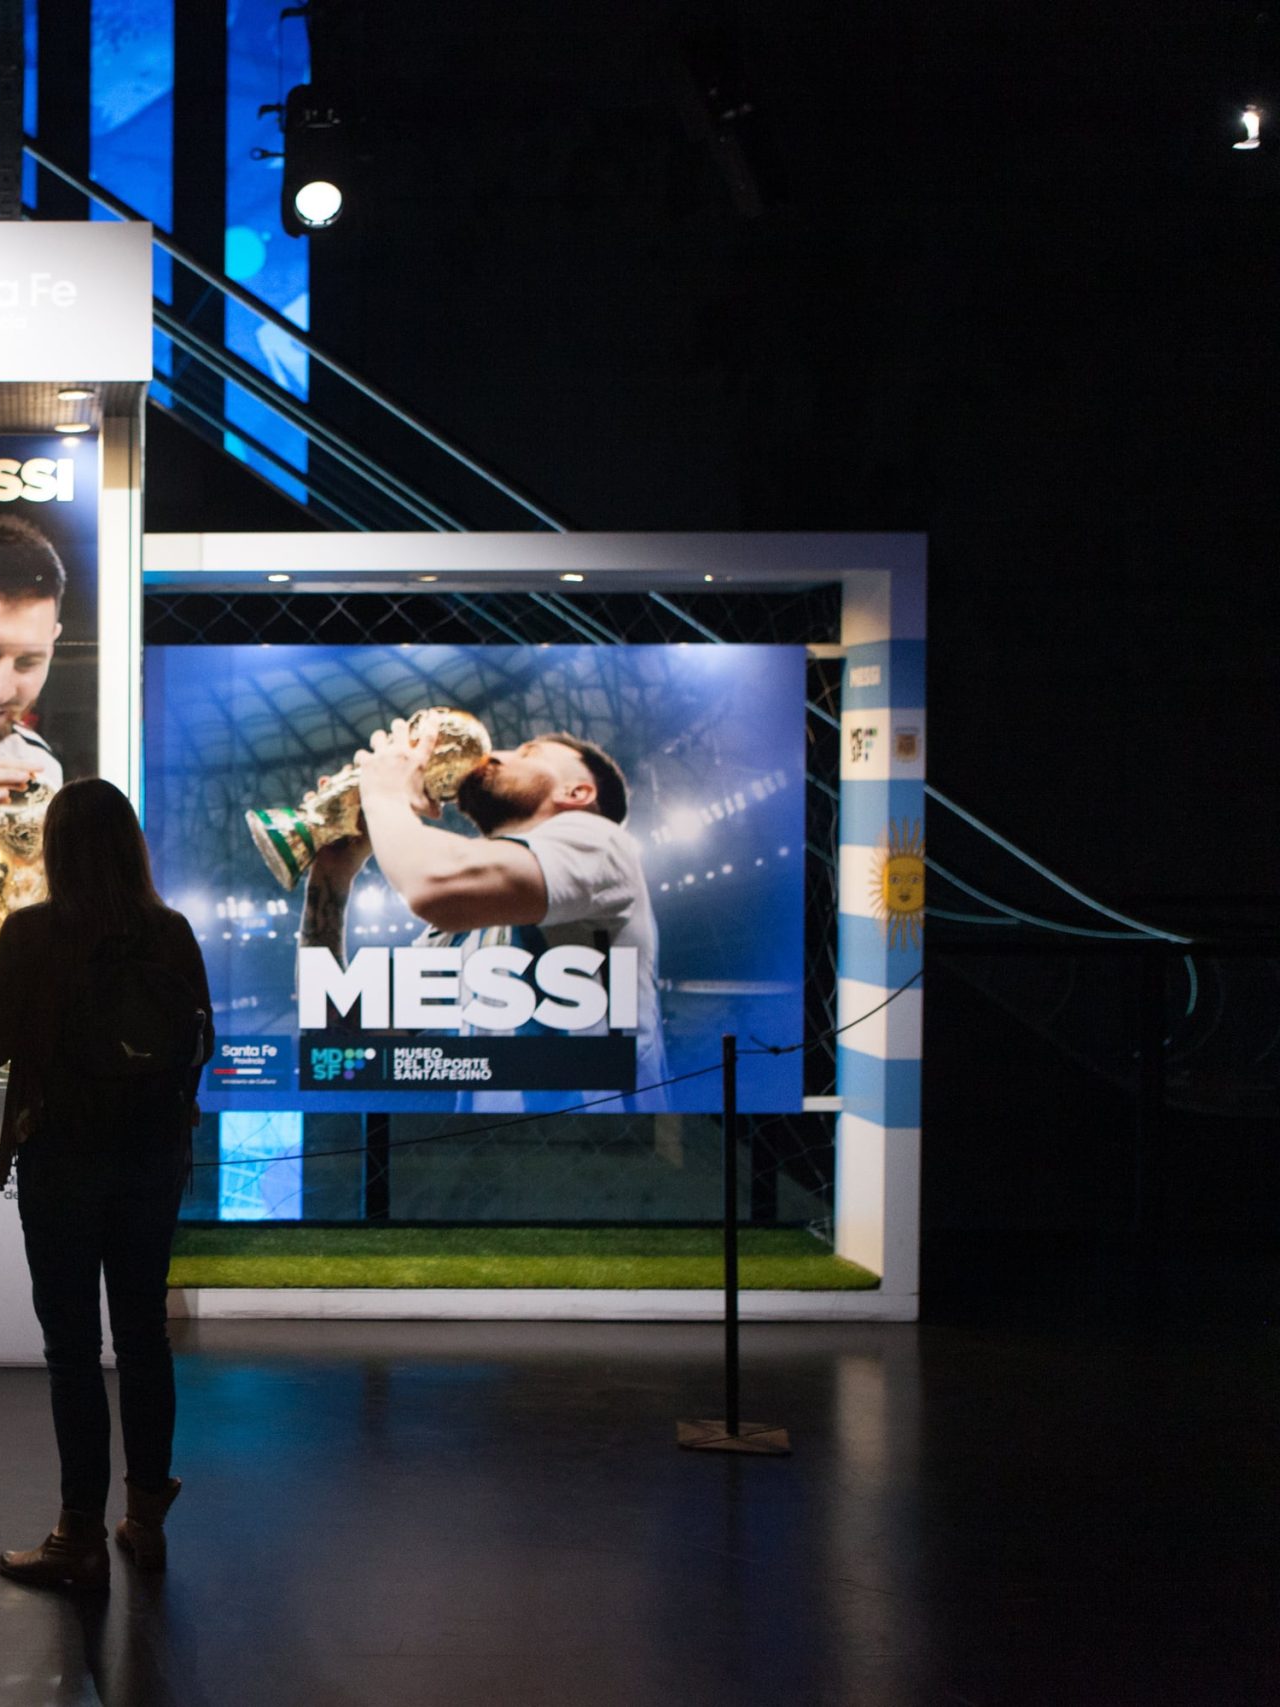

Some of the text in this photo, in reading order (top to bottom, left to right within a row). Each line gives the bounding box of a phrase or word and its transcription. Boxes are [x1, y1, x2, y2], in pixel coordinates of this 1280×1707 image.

[30, 272, 77, 308] Fe
[299, 945, 638, 1031] MESSI
[222, 1044, 278, 1057] Santa Fe
[310, 1048, 343, 1064] MD
[393, 1048, 443, 1059] MUSEO
[394, 1058, 489, 1069] DEL DEPORTE
[312, 1064, 341, 1081] SF
[393, 1069, 492, 1081] SANTAFESINO
